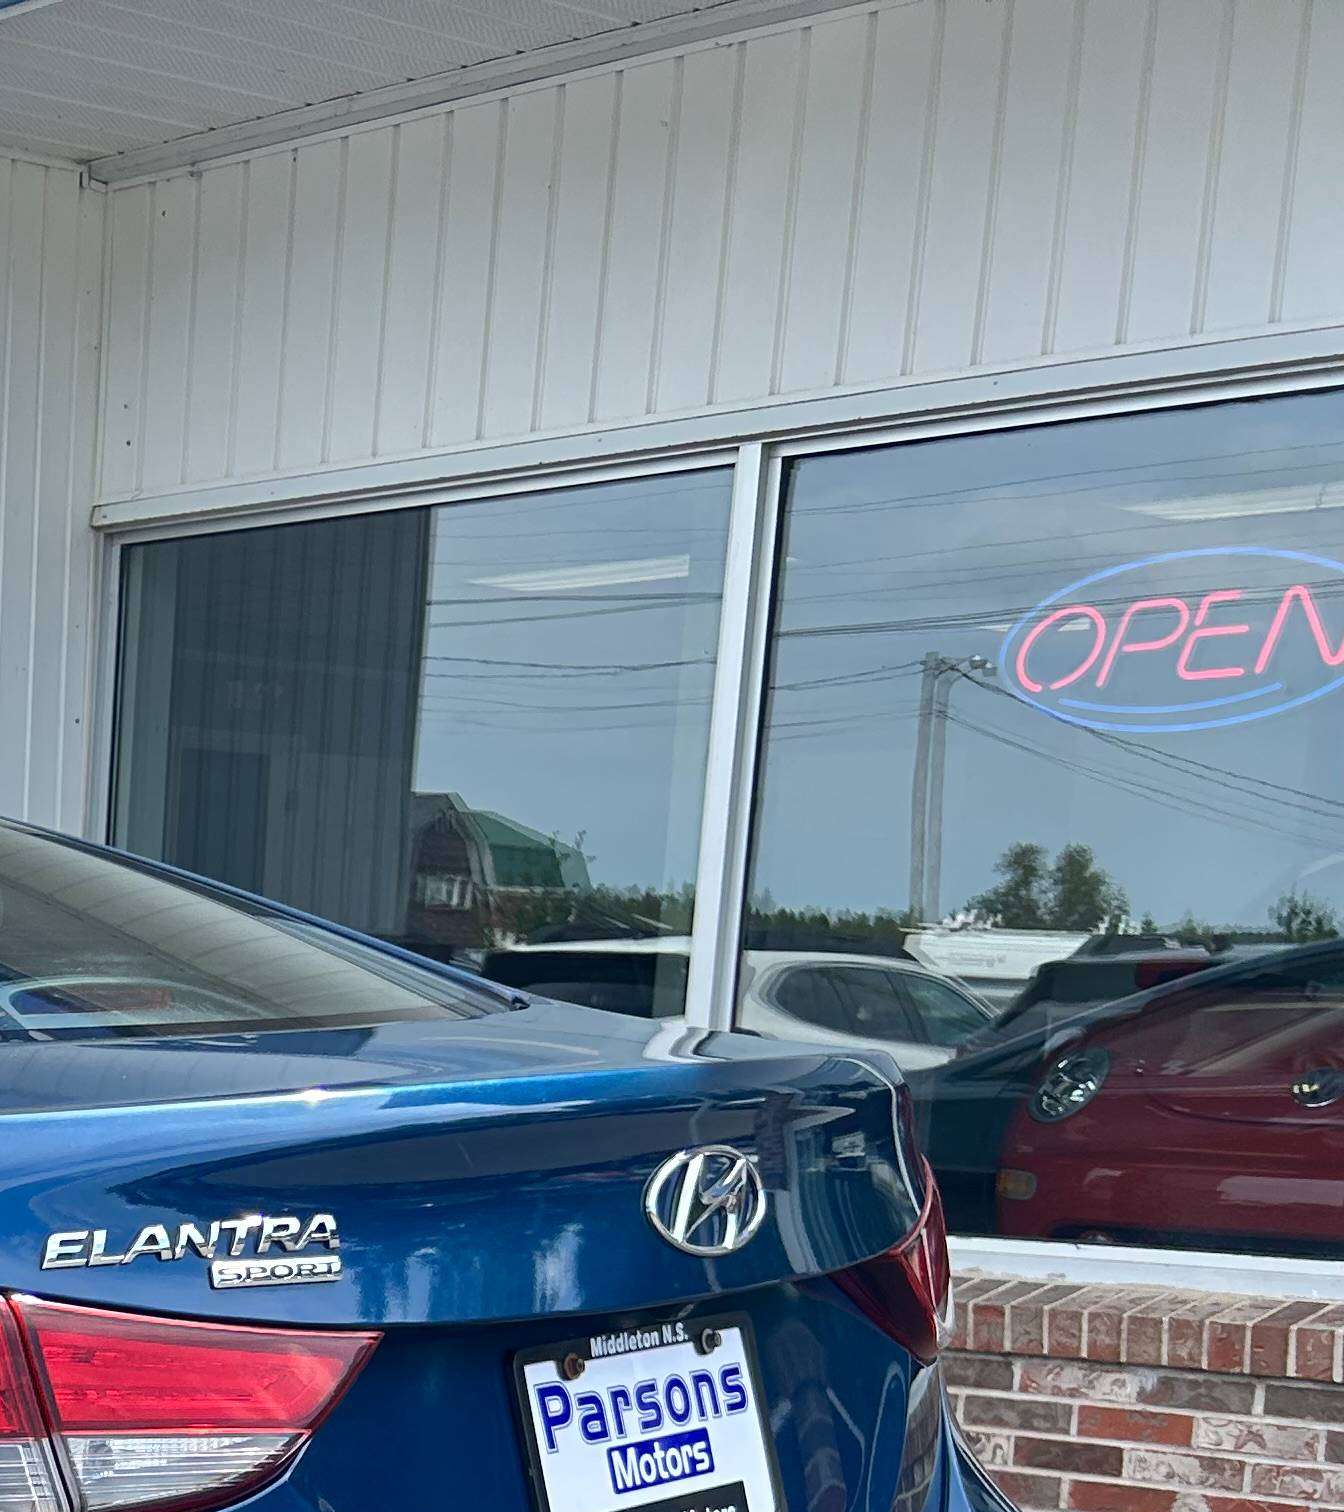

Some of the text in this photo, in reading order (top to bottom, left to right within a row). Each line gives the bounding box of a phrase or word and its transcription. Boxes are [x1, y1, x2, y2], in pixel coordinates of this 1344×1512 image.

[1016, 585, 1344, 693] OPEN
[42, 1213, 341, 1270] ELANTRA
[216, 1260, 341, 1284] SPORT
[590, 1322, 688, 1357] Middleton N.S.
[534, 1362, 749, 1453] Parsons
[612, 1438, 710, 1490] Motors
